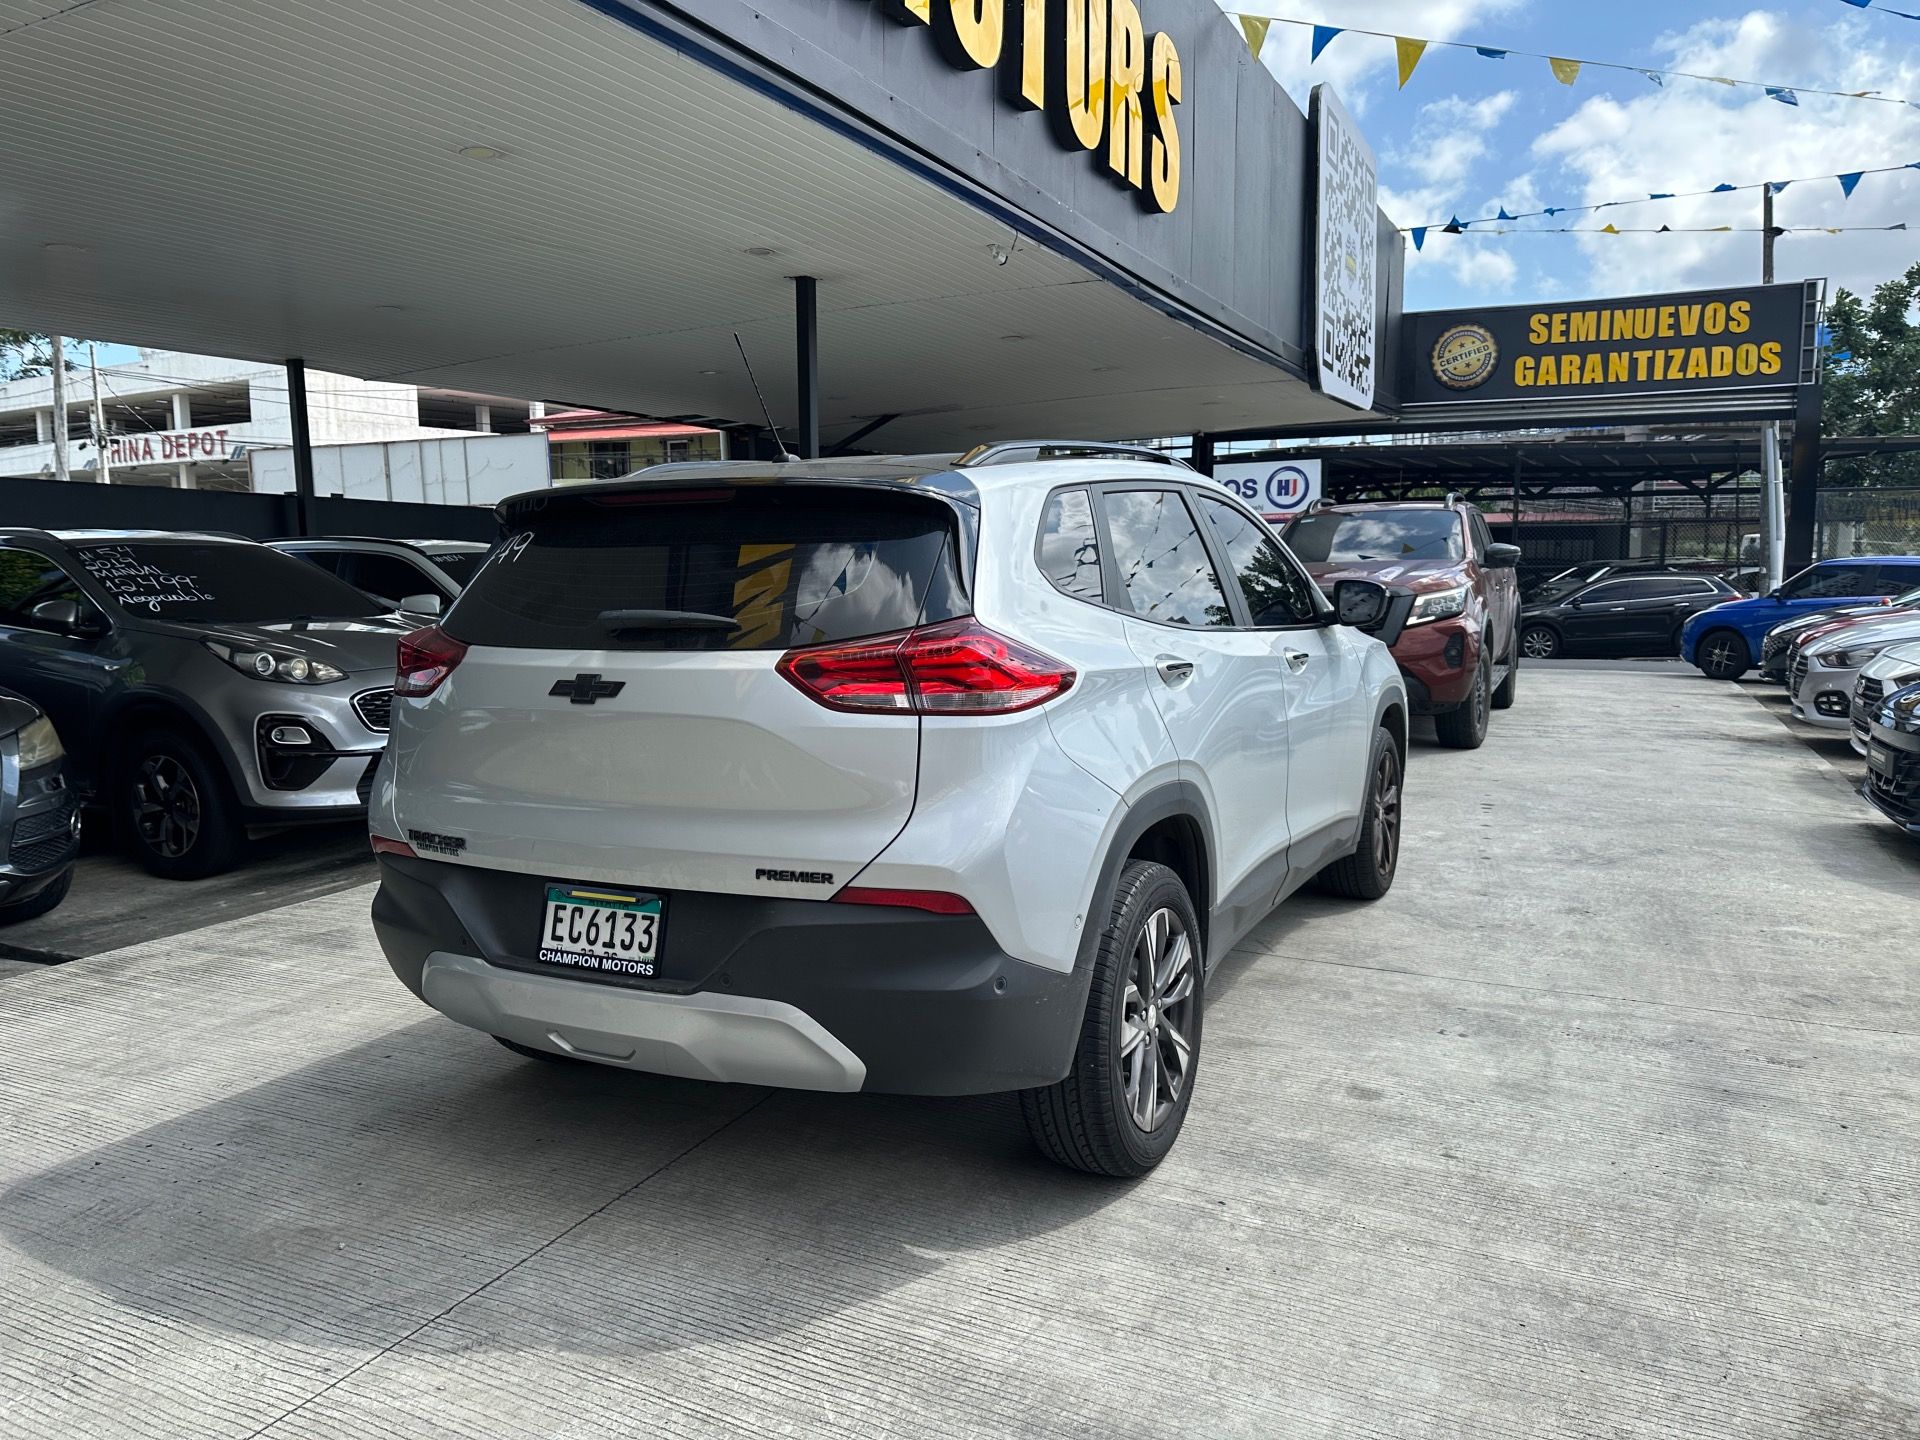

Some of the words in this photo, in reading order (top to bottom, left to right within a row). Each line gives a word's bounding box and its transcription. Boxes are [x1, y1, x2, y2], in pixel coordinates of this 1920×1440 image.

[903, 0, 1182, 213] ORS
[1529, 300, 1751, 345] SEMINUEVOS
[1439, 344, 1490, 367] CERTIFIED
[1514, 341, 1781, 387] GARANTIZADOS
[106, 437, 154, 463] HINA
[162, 430, 228, 459] DEPOT
[1217, 478, 1258, 499] OS
[1276, 479, 1298, 497] HJ
[85, 557, 139, 571] 2019
[92, 565, 170, 578] MANUAL
[118, 589, 215, 612] Negociable
[755, 868, 834, 884] PREMIER
[550, 904, 656, 953] EC6133
[539, 950, 600, 969] CHAMPION
[601, 958, 655, 976] MOTORS
